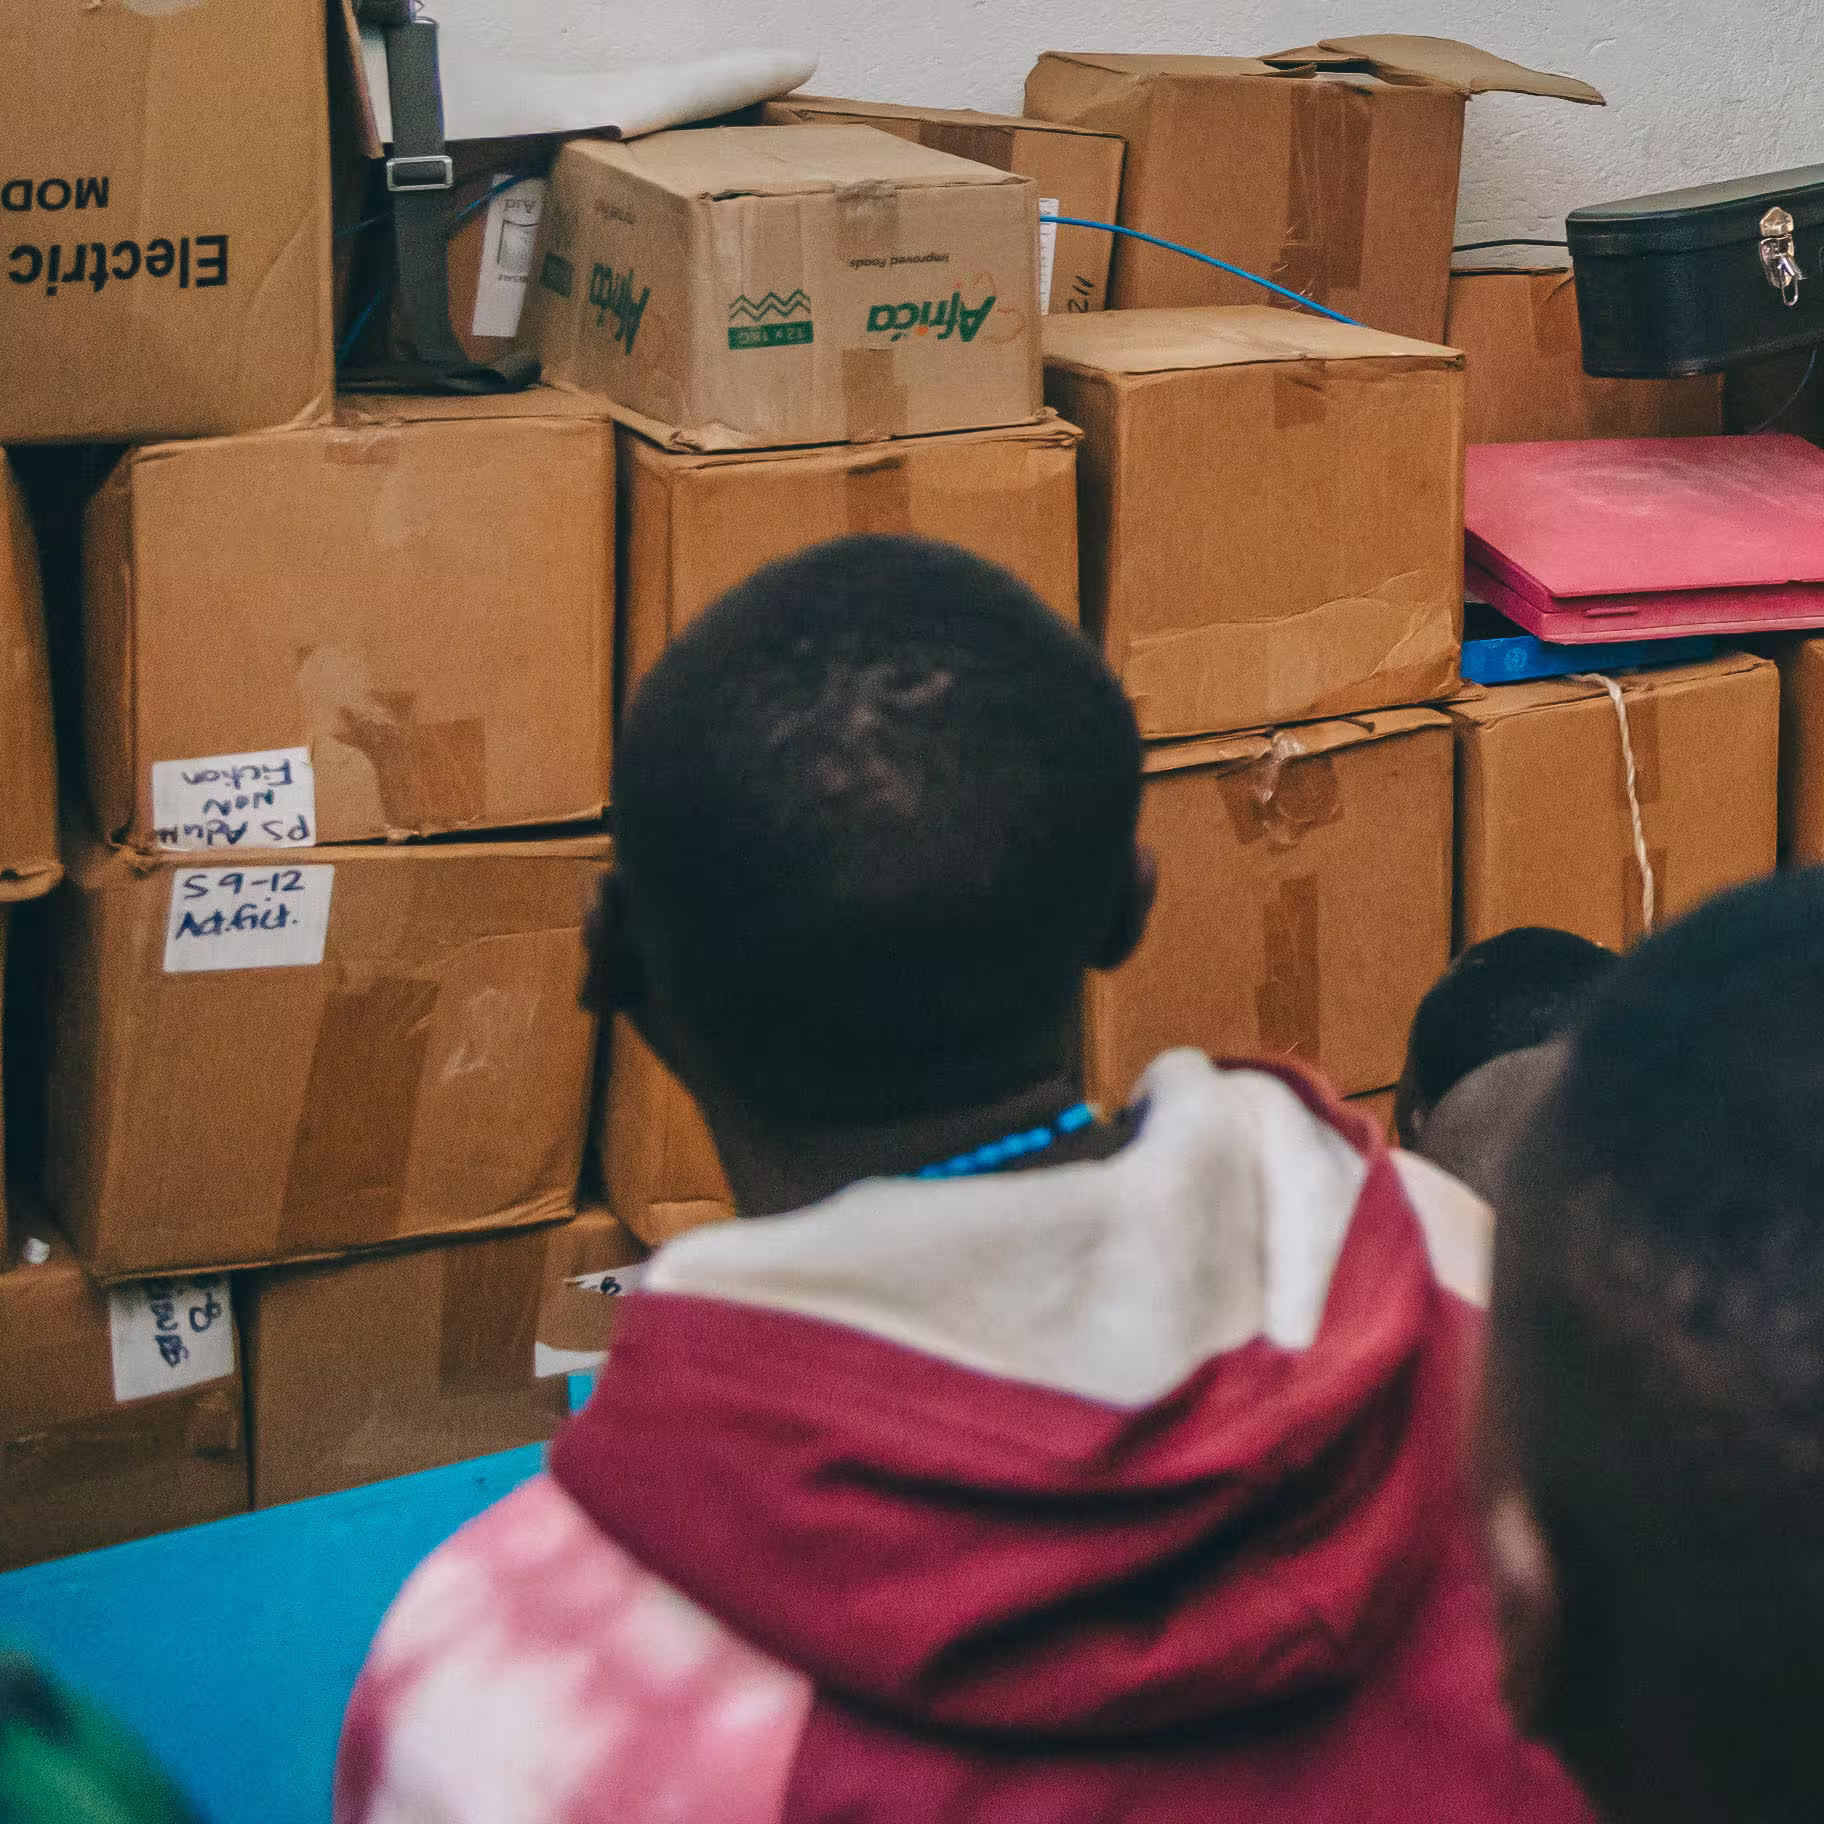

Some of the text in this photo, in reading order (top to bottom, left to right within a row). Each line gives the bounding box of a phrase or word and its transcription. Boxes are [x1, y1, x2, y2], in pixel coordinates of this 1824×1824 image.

[8, 233, 229, 296] Electric
[182, 758, 292, 791] Fiction
[261, 814, 311, 842] PS
